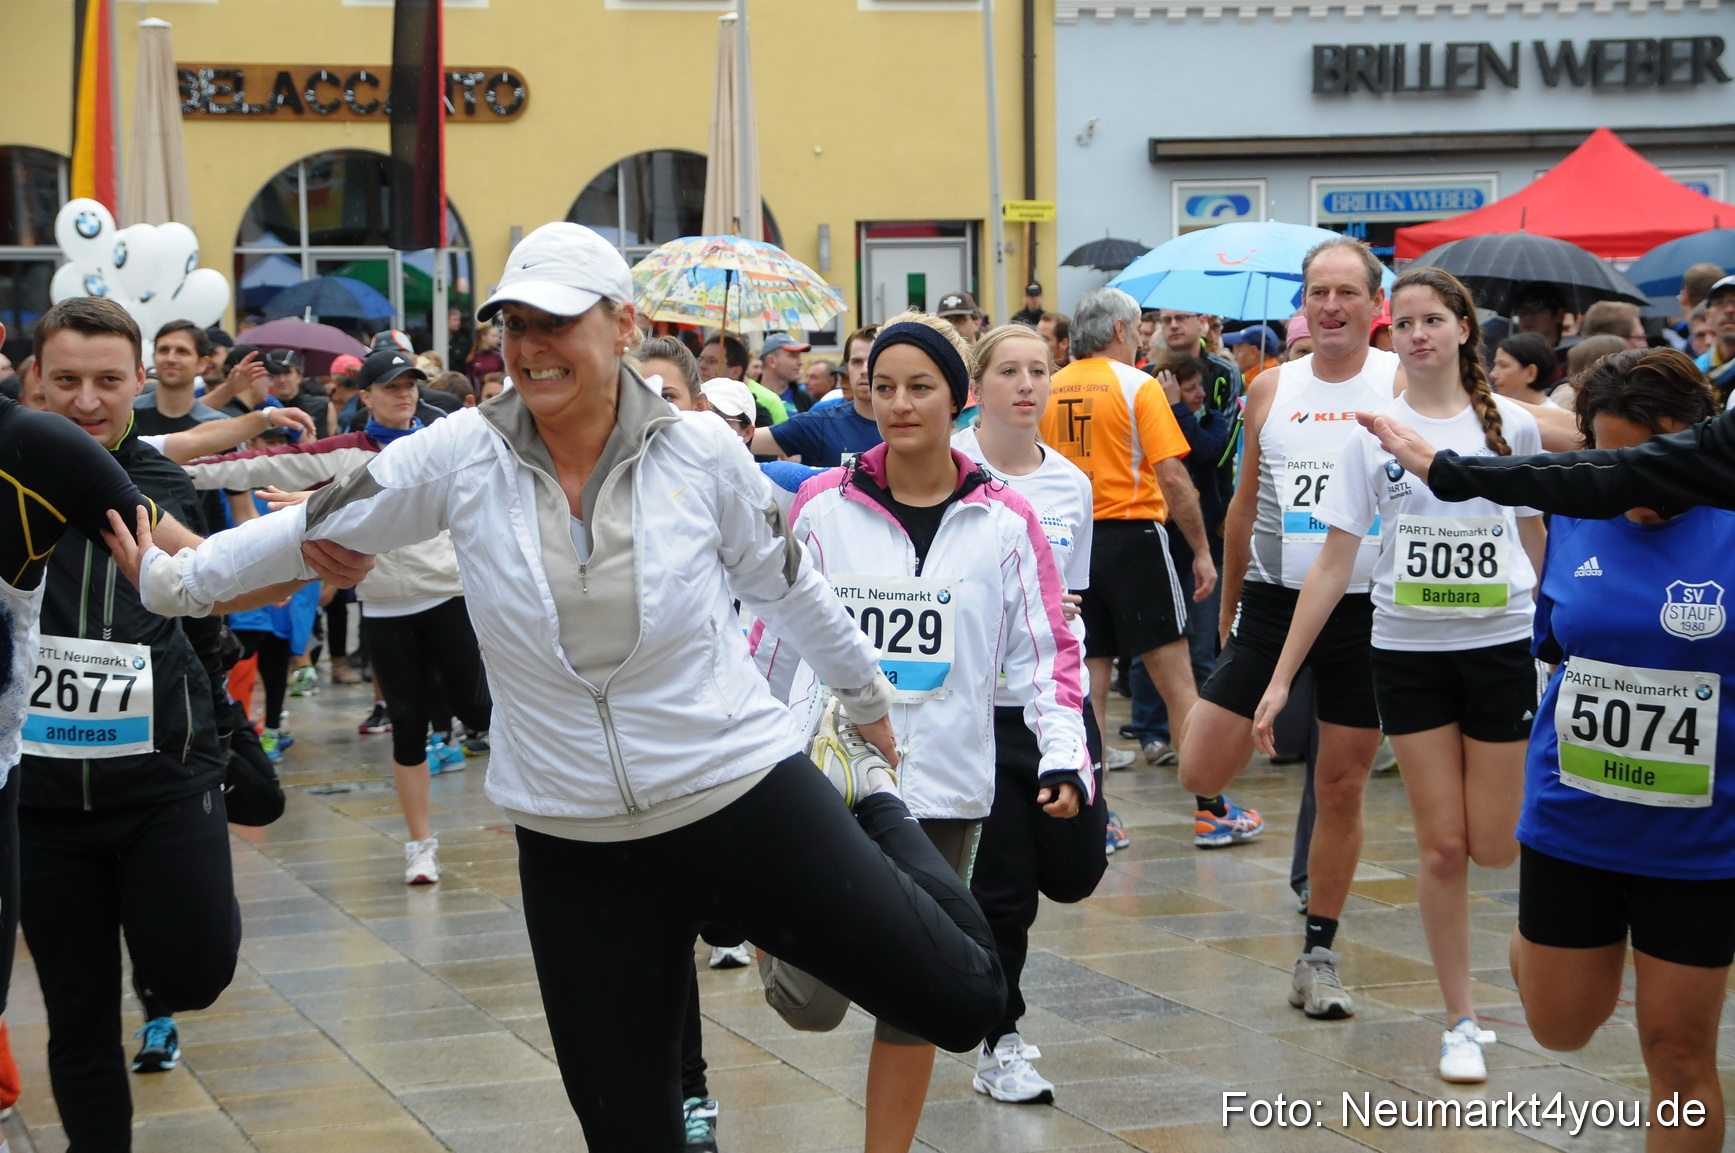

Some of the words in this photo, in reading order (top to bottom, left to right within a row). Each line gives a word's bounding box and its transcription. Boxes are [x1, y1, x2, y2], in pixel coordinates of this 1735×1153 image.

[1312, 41, 1520, 92] BRILLEN
[1532, 36, 1733, 87] WEBER
[177, 69, 525, 115] BELACCTO
[1331, 191, 1406, 212] BRILLEN
[1409, 190, 1477, 210] WEBER
[1288, 461, 1319, 470] PARTL
[1293, 474, 1330, 507] 26
[1388, 482, 1411, 493] PARTL
[1399, 524, 1435, 537] PARTL
[1438, 527, 1488, 538] Neumarkt
[1406, 540, 1499, 579] 5038
[831, 586, 865, 600] ARTL
[868, 588, 932, 602] Neumarkt
[1422, 587, 1480, 604] Barbara
[1682, 588, 1705, 603] SV
[1669, 605, 1717, 621] STAUF
[844, 605, 943, 655] 029
[1679, 621, 1705, 632] 1980
[38, 646, 61, 660] RTL
[63, 650, 128, 668] Neumarkt
[30, 664, 138, 714] 2677
[1564, 670, 1611, 690] PARTL
[1614, 679, 1689, 698] Neumarkt
[46, 725, 117, 742] andreas
[1571, 693, 1700, 756] 5074
[1603, 759, 1656, 786] Hilde
